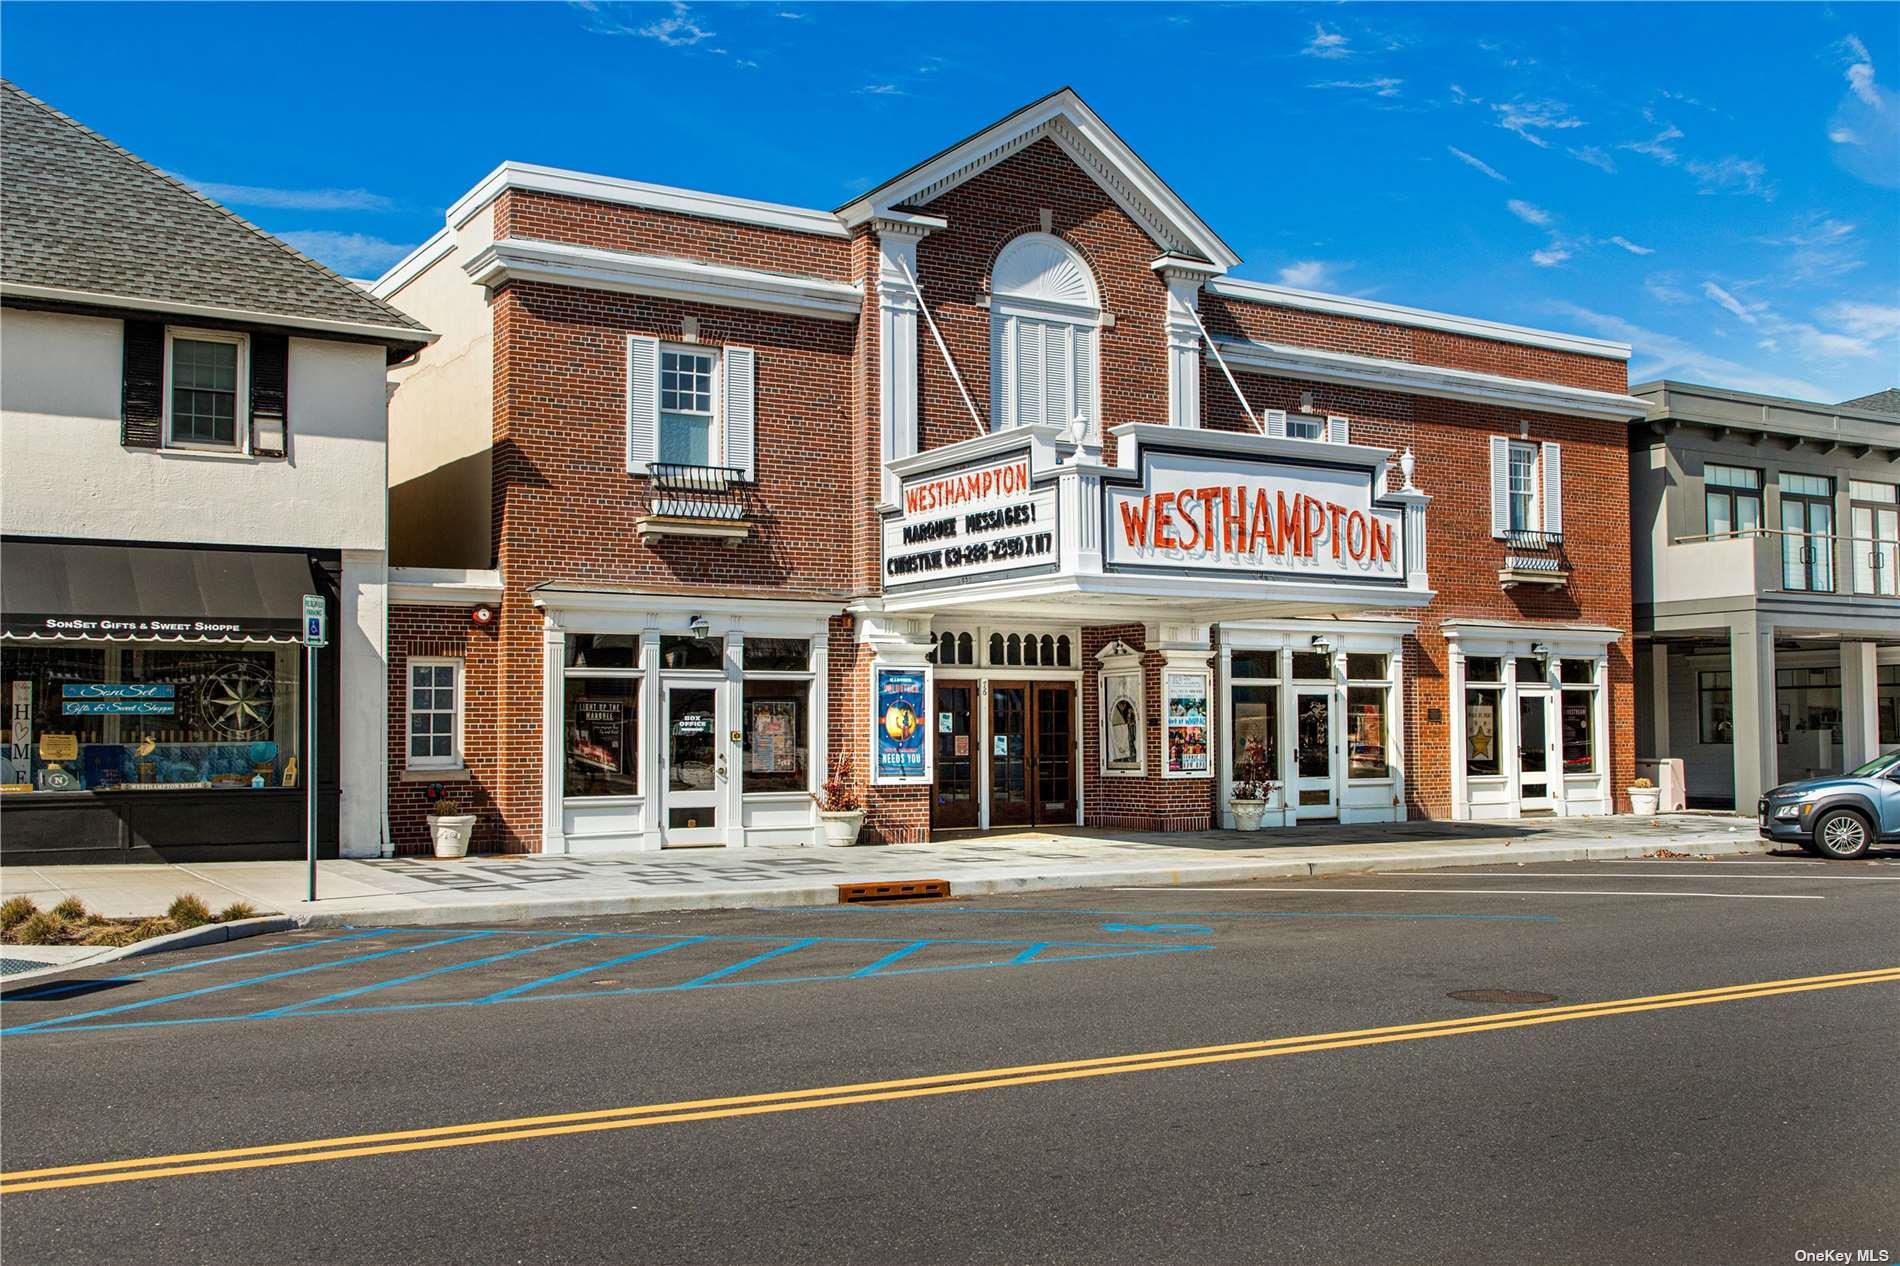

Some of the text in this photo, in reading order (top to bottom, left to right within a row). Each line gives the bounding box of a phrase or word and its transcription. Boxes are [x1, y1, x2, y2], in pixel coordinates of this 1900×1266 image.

[905, 463, 1028, 514] WESTHAMPTON
[903, 502, 1036, 545] MARQUEE MESSAGES!
[1119, 485, 1393, 562] WESTHAMPTON
[887, 550, 943, 575] CHRISTINE
[1025, 535, 1034, 556] X
[101, 620, 137, 630] GIFTS
[139, 622, 148, 630] &
[150, 621, 191, 631] SWEET
[194, 622, 240, 632] SHOPPE
[882, 753, 921, 764] NEEDS YOU
